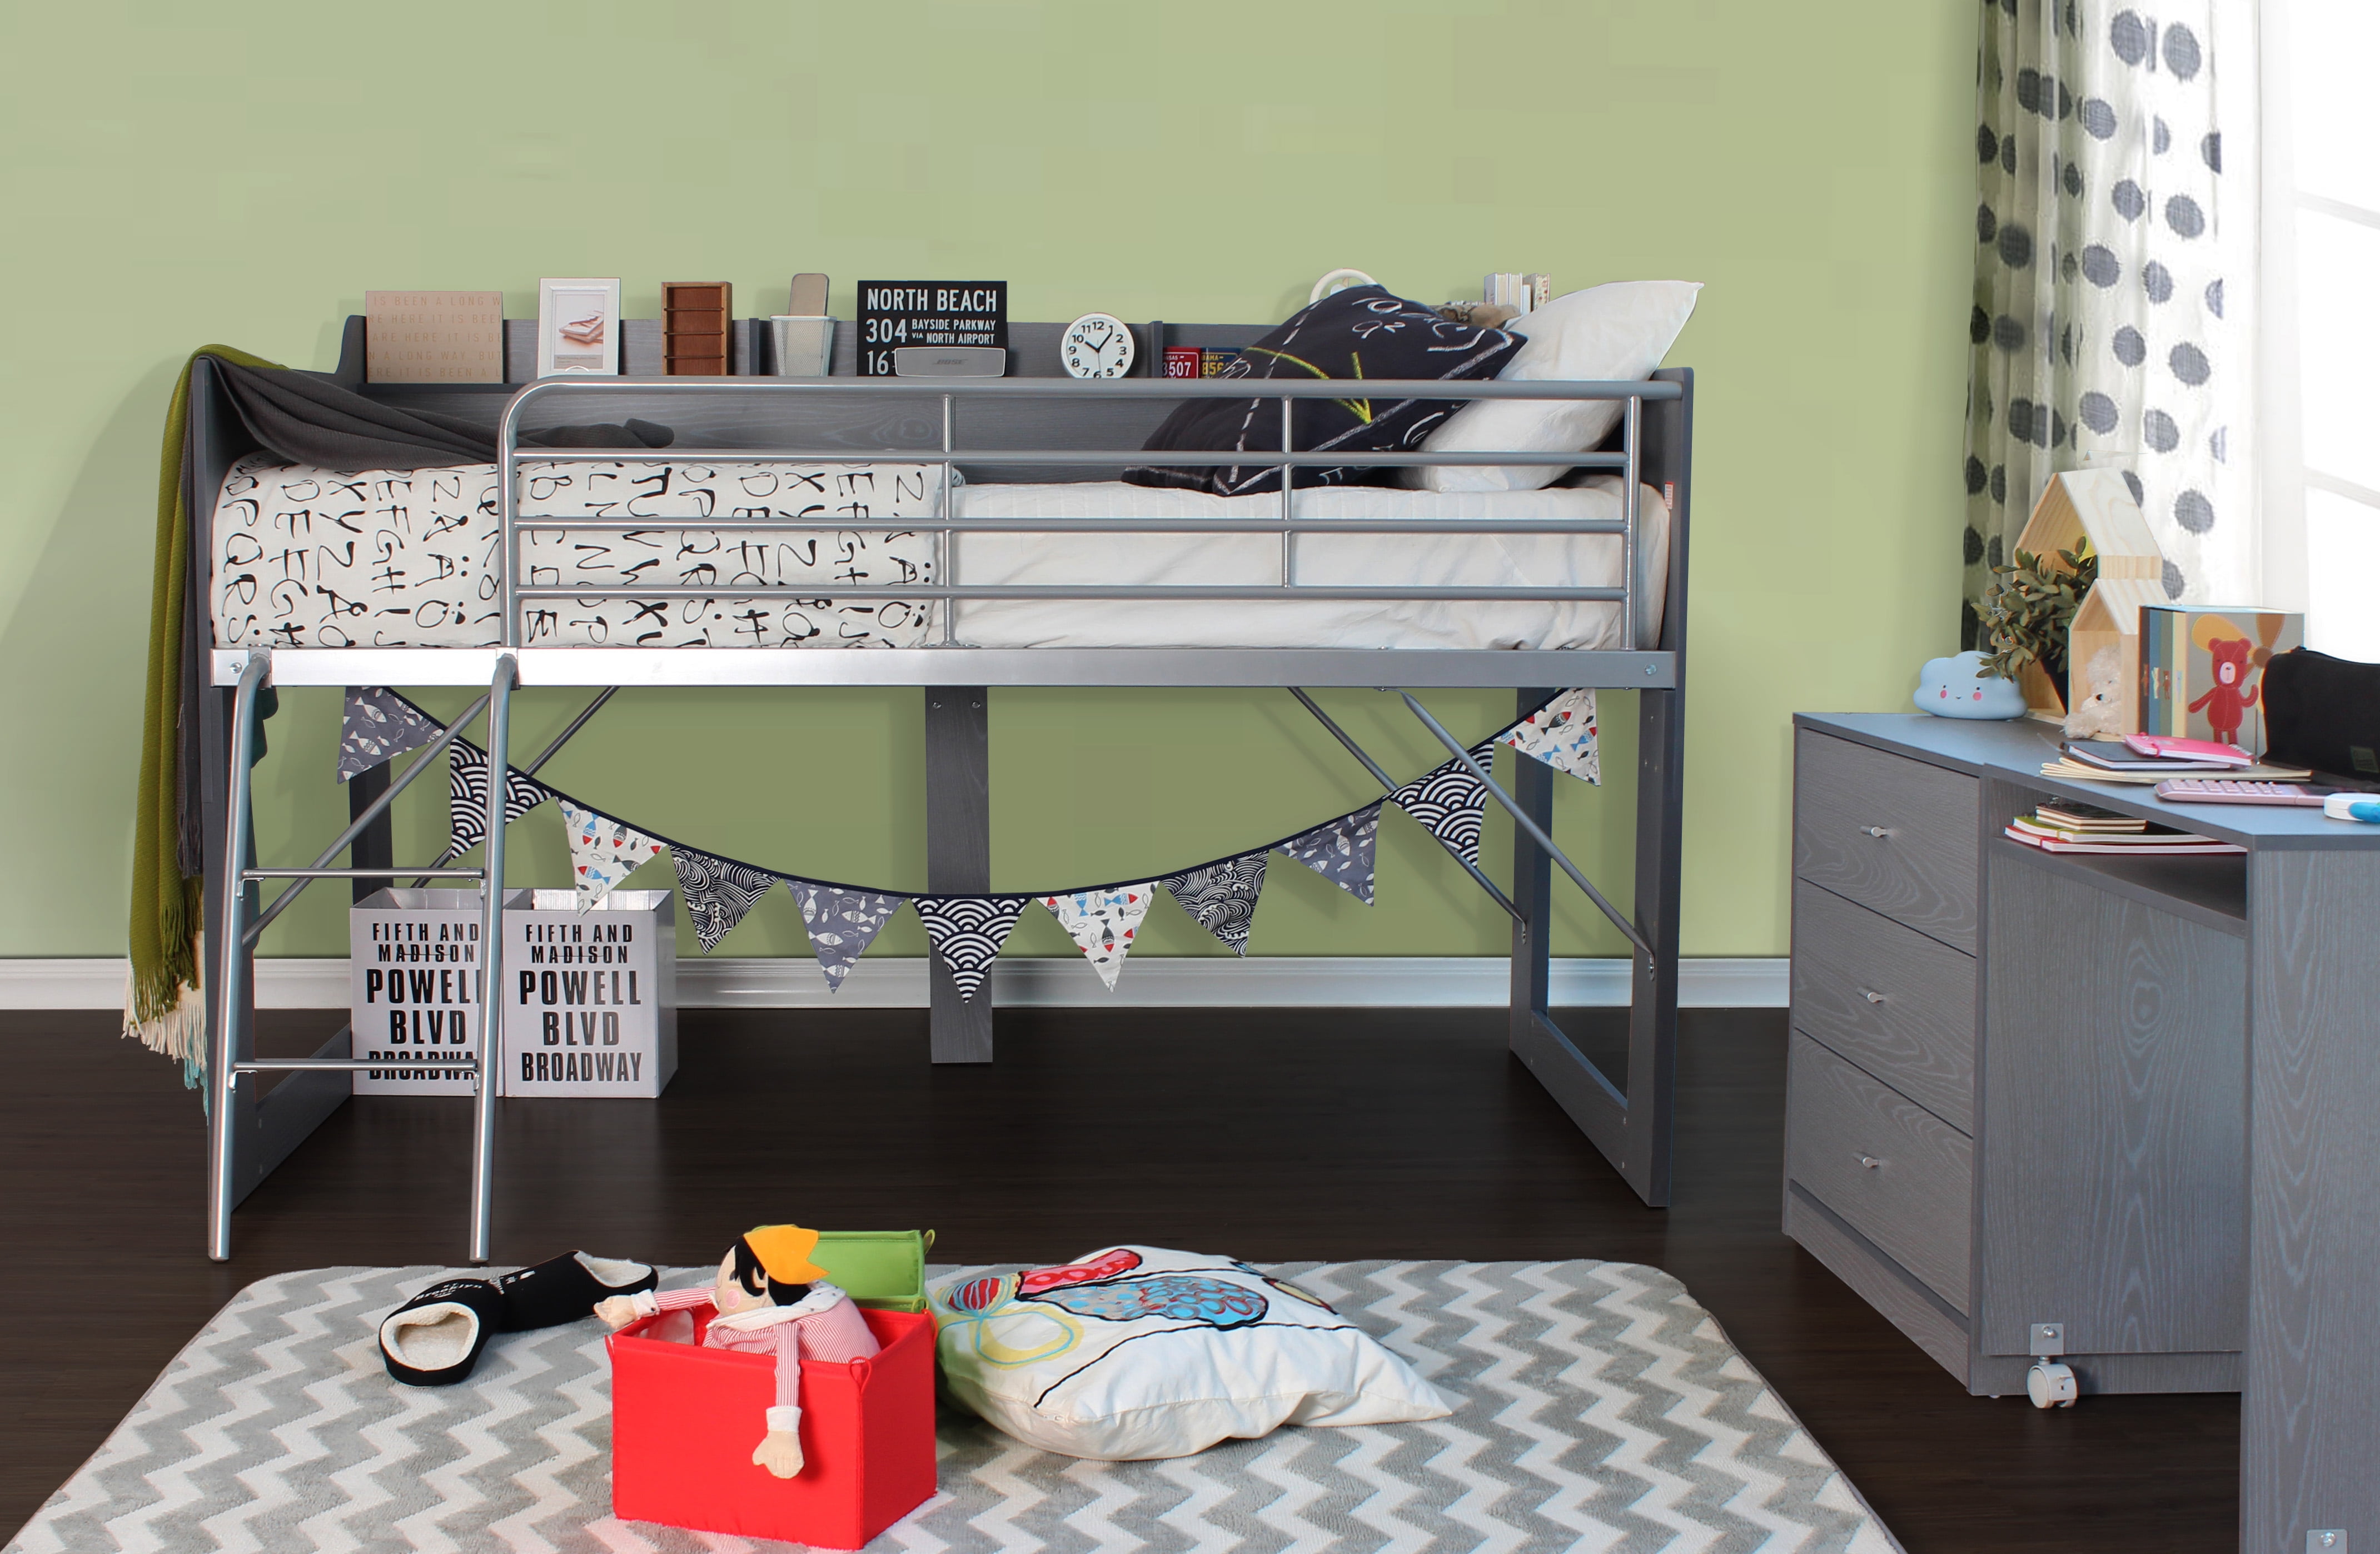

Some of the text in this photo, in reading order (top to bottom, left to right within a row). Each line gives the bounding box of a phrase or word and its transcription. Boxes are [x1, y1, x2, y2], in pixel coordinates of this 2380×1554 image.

[395, 297, 427, 306] BEEN
[450, 297, 484, 306] LONG
[867, 288, 997, 312] NORTH BEACH
[391, 314, 424, 323] HERE
[912, 318, 996, 331] BAYSIDE PARKWAY
[1081, 325, 1091, 333] 11
[1092, 321, 1104, 331] 12
[1108, 325, 1113, 334] 1
[865, 318, 907, 343] 304
[405, 333, 437, 342] HERE
[927, 333, 954, 344] NORTH
[958, 333, 995, 345] AIRPORT
[1072, 334, 1084, 343] 10
[1116, 333, 1123, 343] 2
[399, 351, 432, 360] LONG
[441, 351, 466, 360] WAY
[1068, 346, 1077, 355] 9
[1119, 346, 1127, 356] 3
[867, 350, 895, 375] 16
[1072, 358, 1080, 367] 8
[1115, 358, 1124, 367] 4
[440, 368, 472, 377] BEEN
[1082, 367, 1089, 377] 7
[1106, 368, 1114, 376] 5
[373, 923, 479, 942] FIFTH AND
[526, 924, 633, 943] FIFTH AND
[379, 944, 475, 963] MADISON
[532, 945, 628, 964] MADISON
[520, 970, 641, 1005] POWELL
[390, 1010, 466, 1044] BLVD
[543, 1012, 620, 1046] BLVD
[369, 1051, 475, 1080] BROADWA
[522, 1052, 642, 1082] BROADWAY
